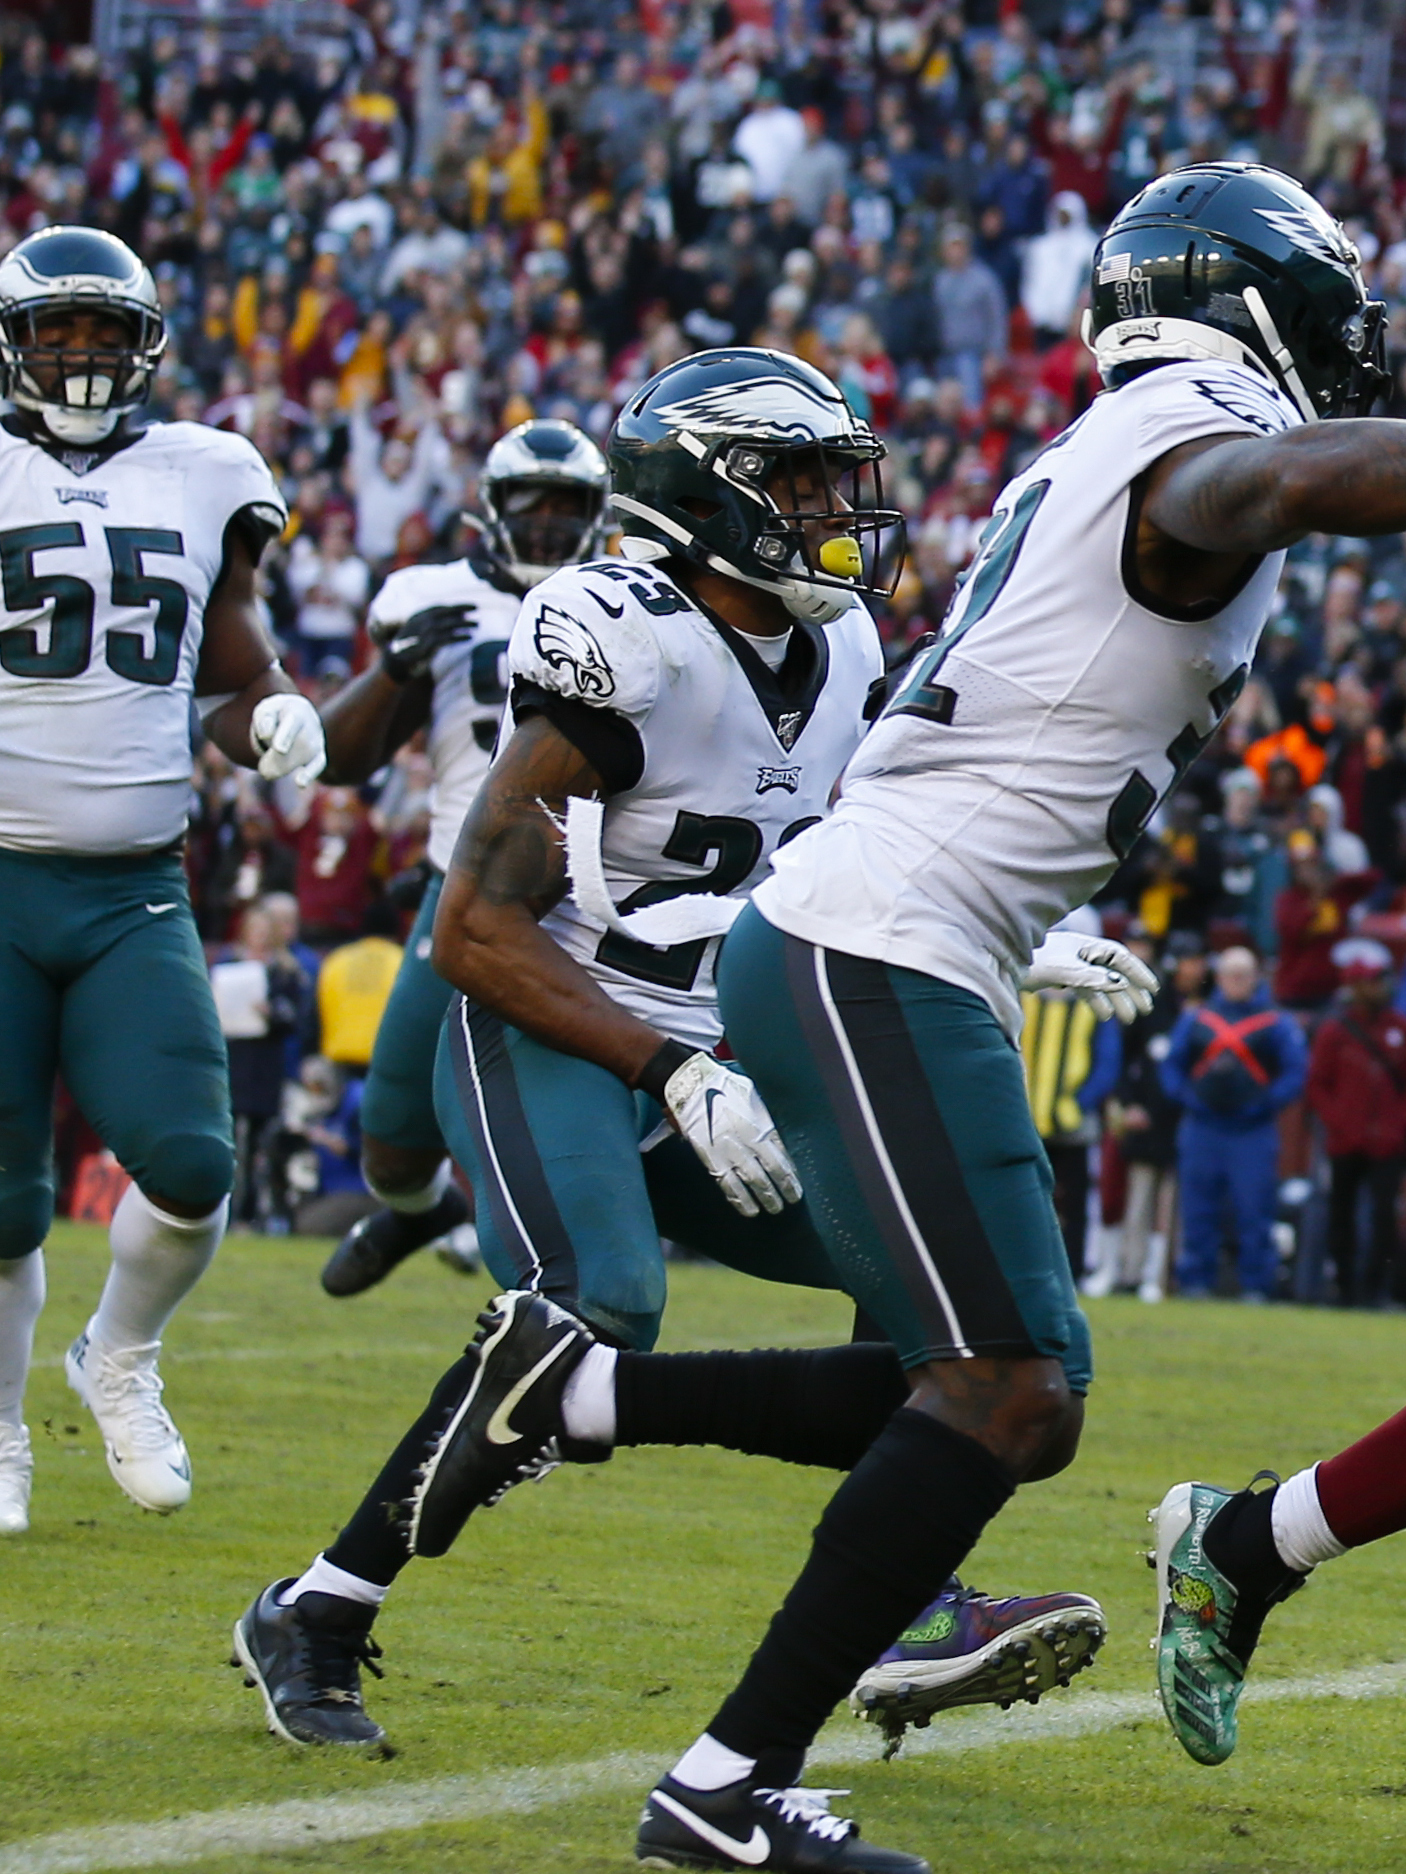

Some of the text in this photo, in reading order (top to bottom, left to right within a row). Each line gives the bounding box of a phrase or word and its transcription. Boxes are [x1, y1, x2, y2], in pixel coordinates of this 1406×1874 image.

[1115, 277, 1158, 318] 31
[0, 521, 190, 686] 55
[595, 808, 825, 992] 2
